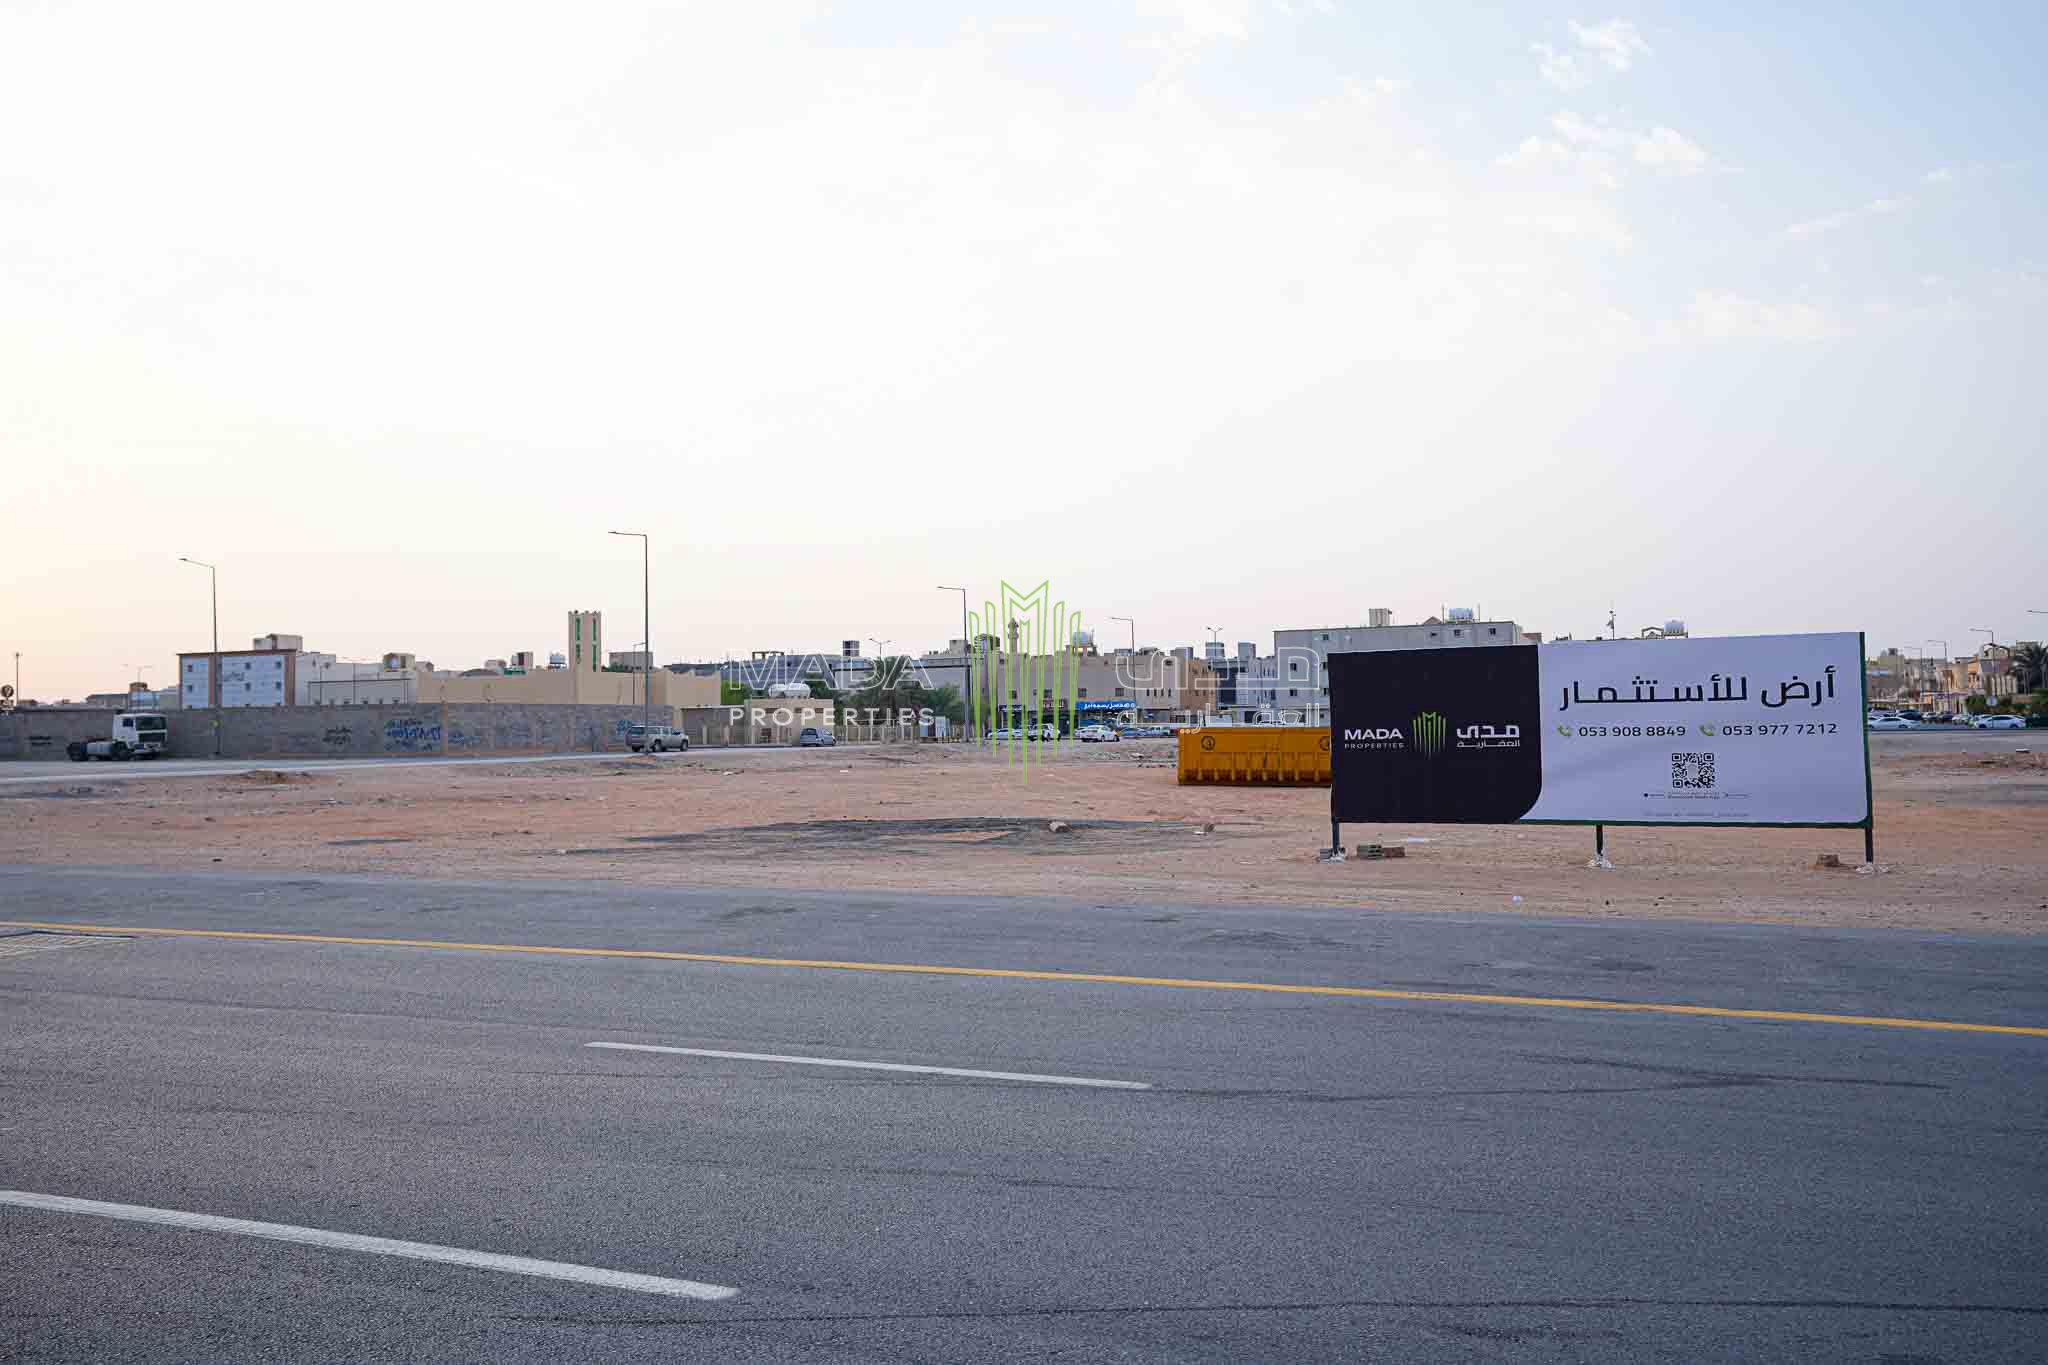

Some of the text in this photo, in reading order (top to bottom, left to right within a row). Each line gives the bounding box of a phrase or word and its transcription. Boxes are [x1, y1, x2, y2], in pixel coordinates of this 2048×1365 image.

[1559, 664, 1836, 711] أرض للأستثمار
[1344, 728, 1404, 741] MADA
[1578, 725, 1686, 738] 053 908 8849
[1722, 722, 1837, 737] 053 977 7212
[1344, 742, 1405, 750] PROPERTIES
